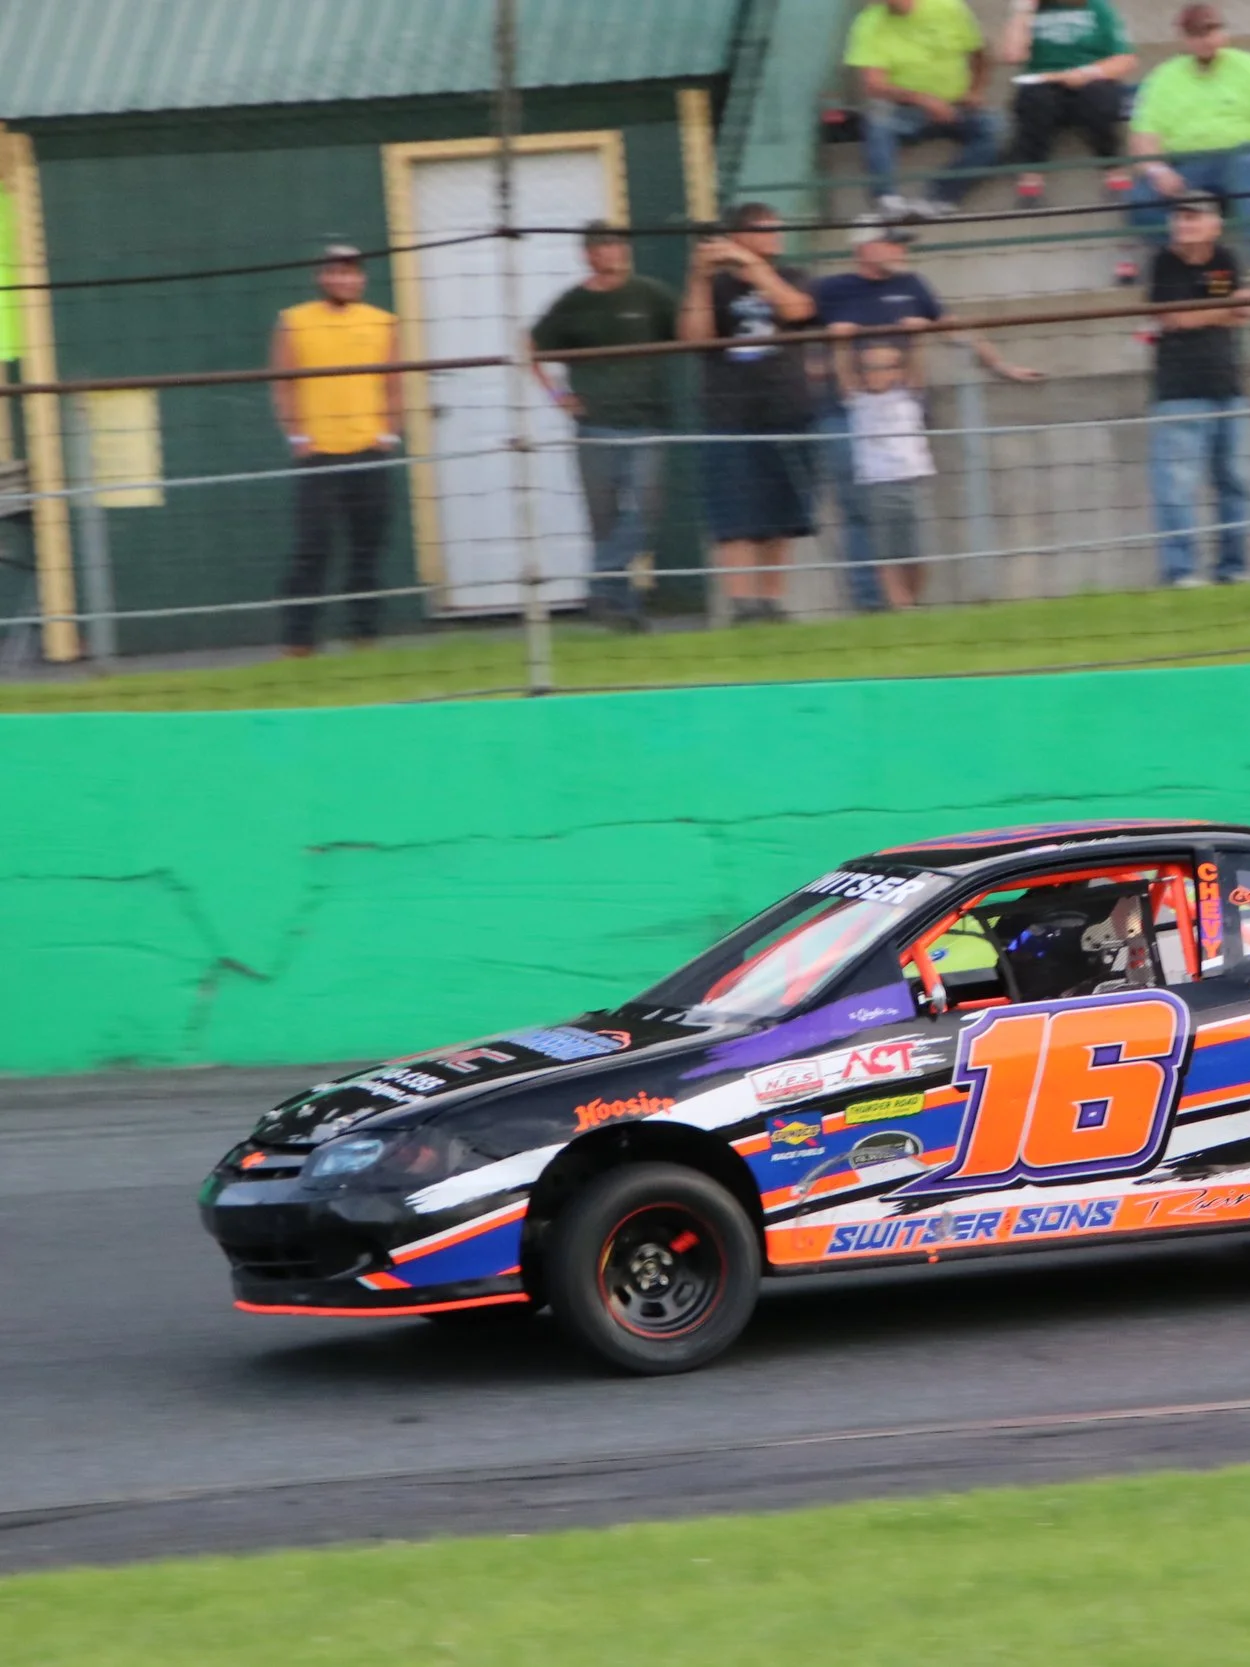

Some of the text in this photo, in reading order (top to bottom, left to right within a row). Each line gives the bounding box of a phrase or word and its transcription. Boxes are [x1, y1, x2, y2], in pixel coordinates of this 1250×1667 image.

[1197, 862, 1223, 959] CHEVY
[841, 1042, 916, 1079] ACT
[573, 1090, 677, 1133] Hoosier
[950, 989, 1191, 1192] 16
[827, 1209, 1002, 1254] SWITSER
[1011, 1198, 1122, 1236] SONS
